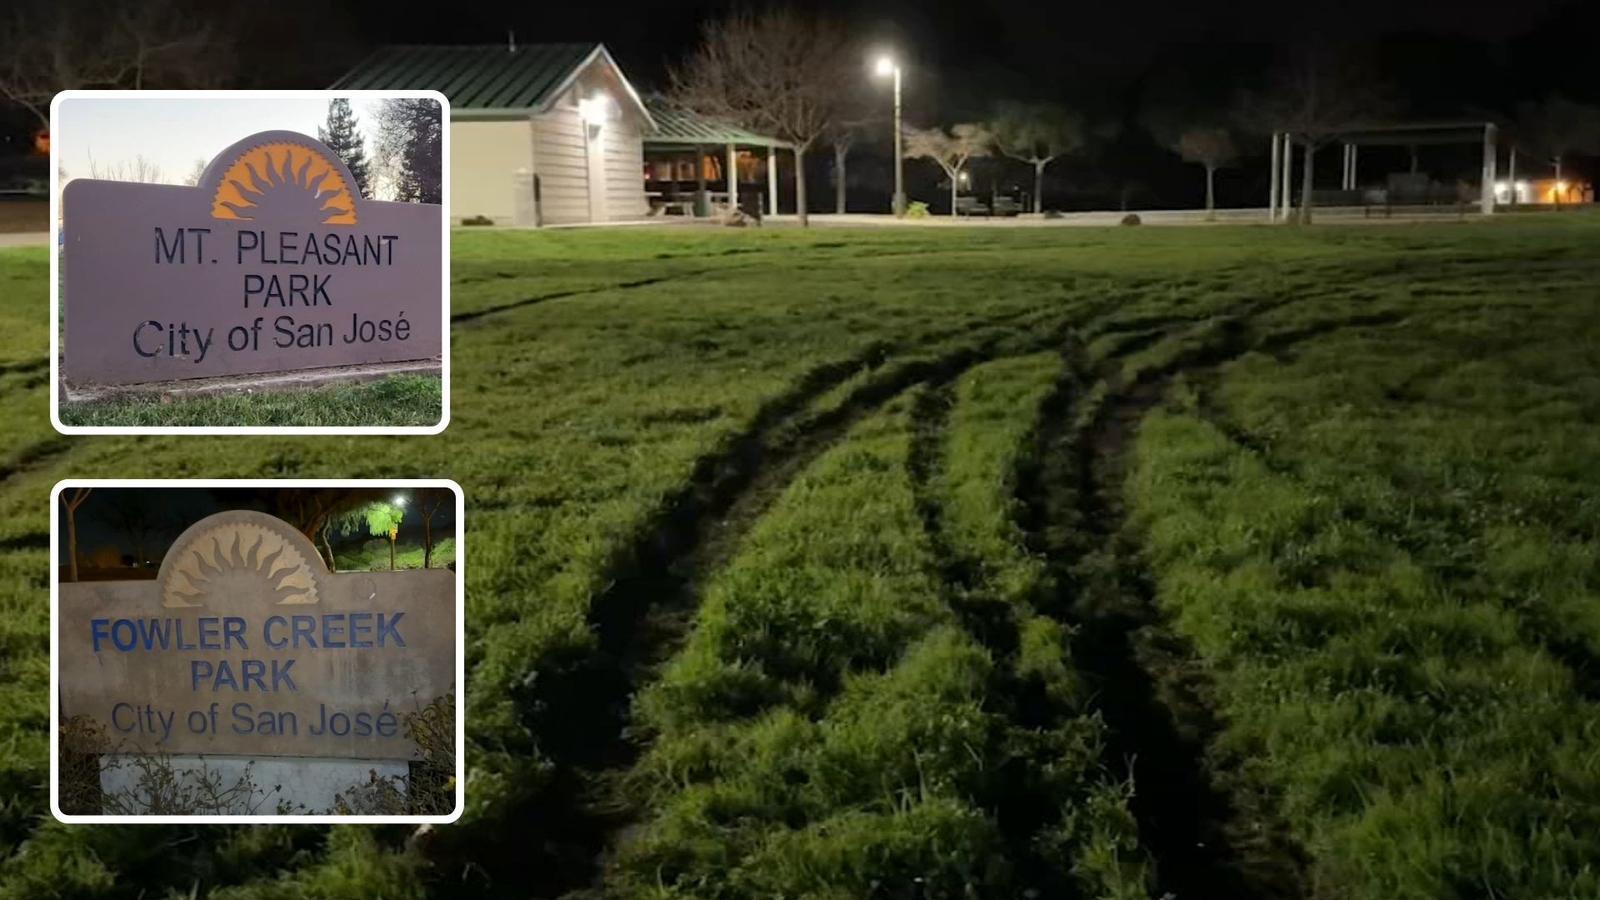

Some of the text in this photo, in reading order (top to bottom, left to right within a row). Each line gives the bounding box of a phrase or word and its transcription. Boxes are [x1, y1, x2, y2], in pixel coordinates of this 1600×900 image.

[154, 227, 399, 266] MT. PLEASANT
[243, 274, 332, 308] PARK
[133, 311, 411, 364] City of San José
[90, 612, 406, 652] FOWLER CREEK
[191, 659, 297, 692] PARK
[111, 699, 398, 741] City of San José
